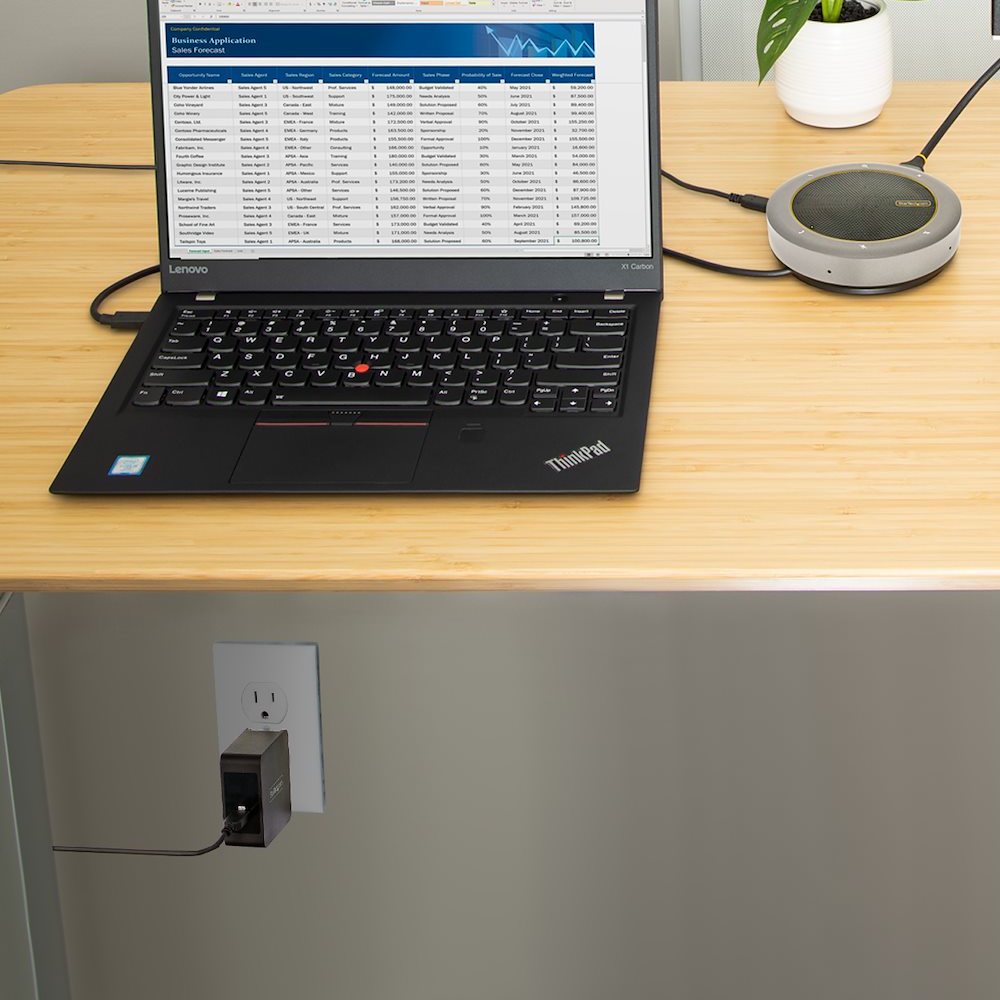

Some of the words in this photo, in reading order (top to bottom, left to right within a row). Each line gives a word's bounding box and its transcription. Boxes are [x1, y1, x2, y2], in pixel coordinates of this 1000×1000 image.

[209, 37, 257, 45] Application
[169, 265, 208, 274] Lenovo
[545, 440, 611, 471] ThinkPad
